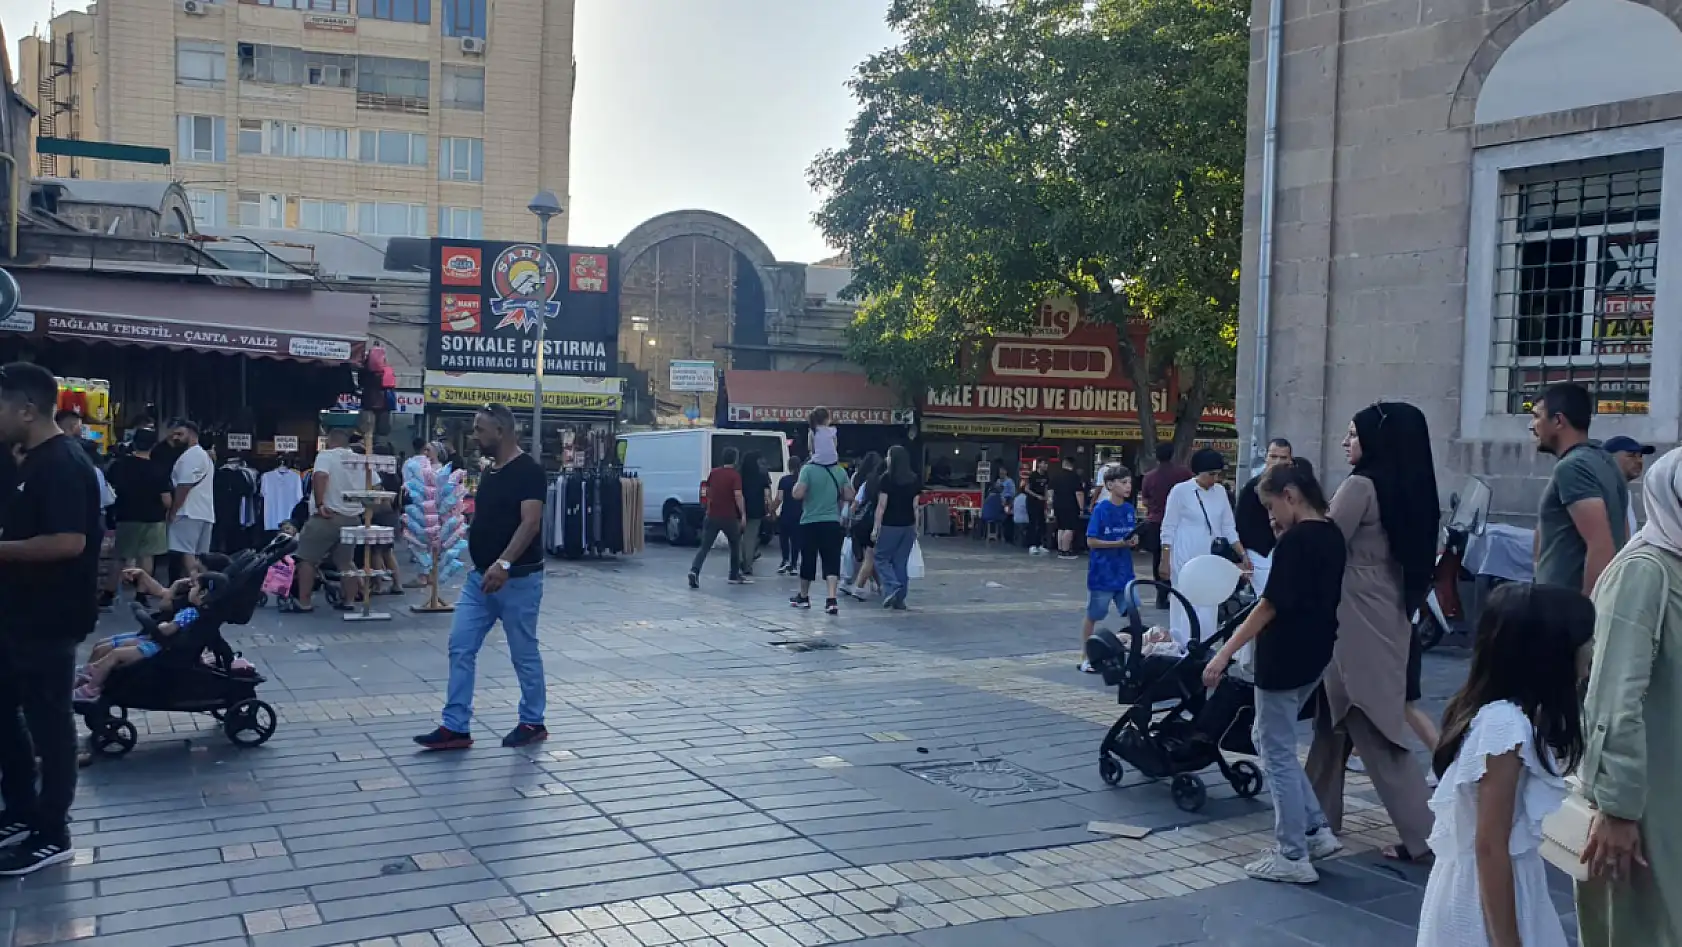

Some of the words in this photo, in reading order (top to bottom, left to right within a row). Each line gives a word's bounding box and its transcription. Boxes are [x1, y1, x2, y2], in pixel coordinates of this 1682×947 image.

[48, 316, 109, 332] SAĞLAM
[112, 324, 172, 338] TEKSTİL
[184, 330, 228, 343] ÇANTA
[240, 335, 278, 347] VALİZ
[441, 335, 516, 353] SOYKALE
[441, 355, 517, 369] PASTIRMACI
[522, 358, 606, 372] BUHANETTİN
[976, 385, 1038, 412] TURŞU
[1043, 387, 1065, 411] VE
[1069, 385, 1167, 413] DÖNERCSİ
